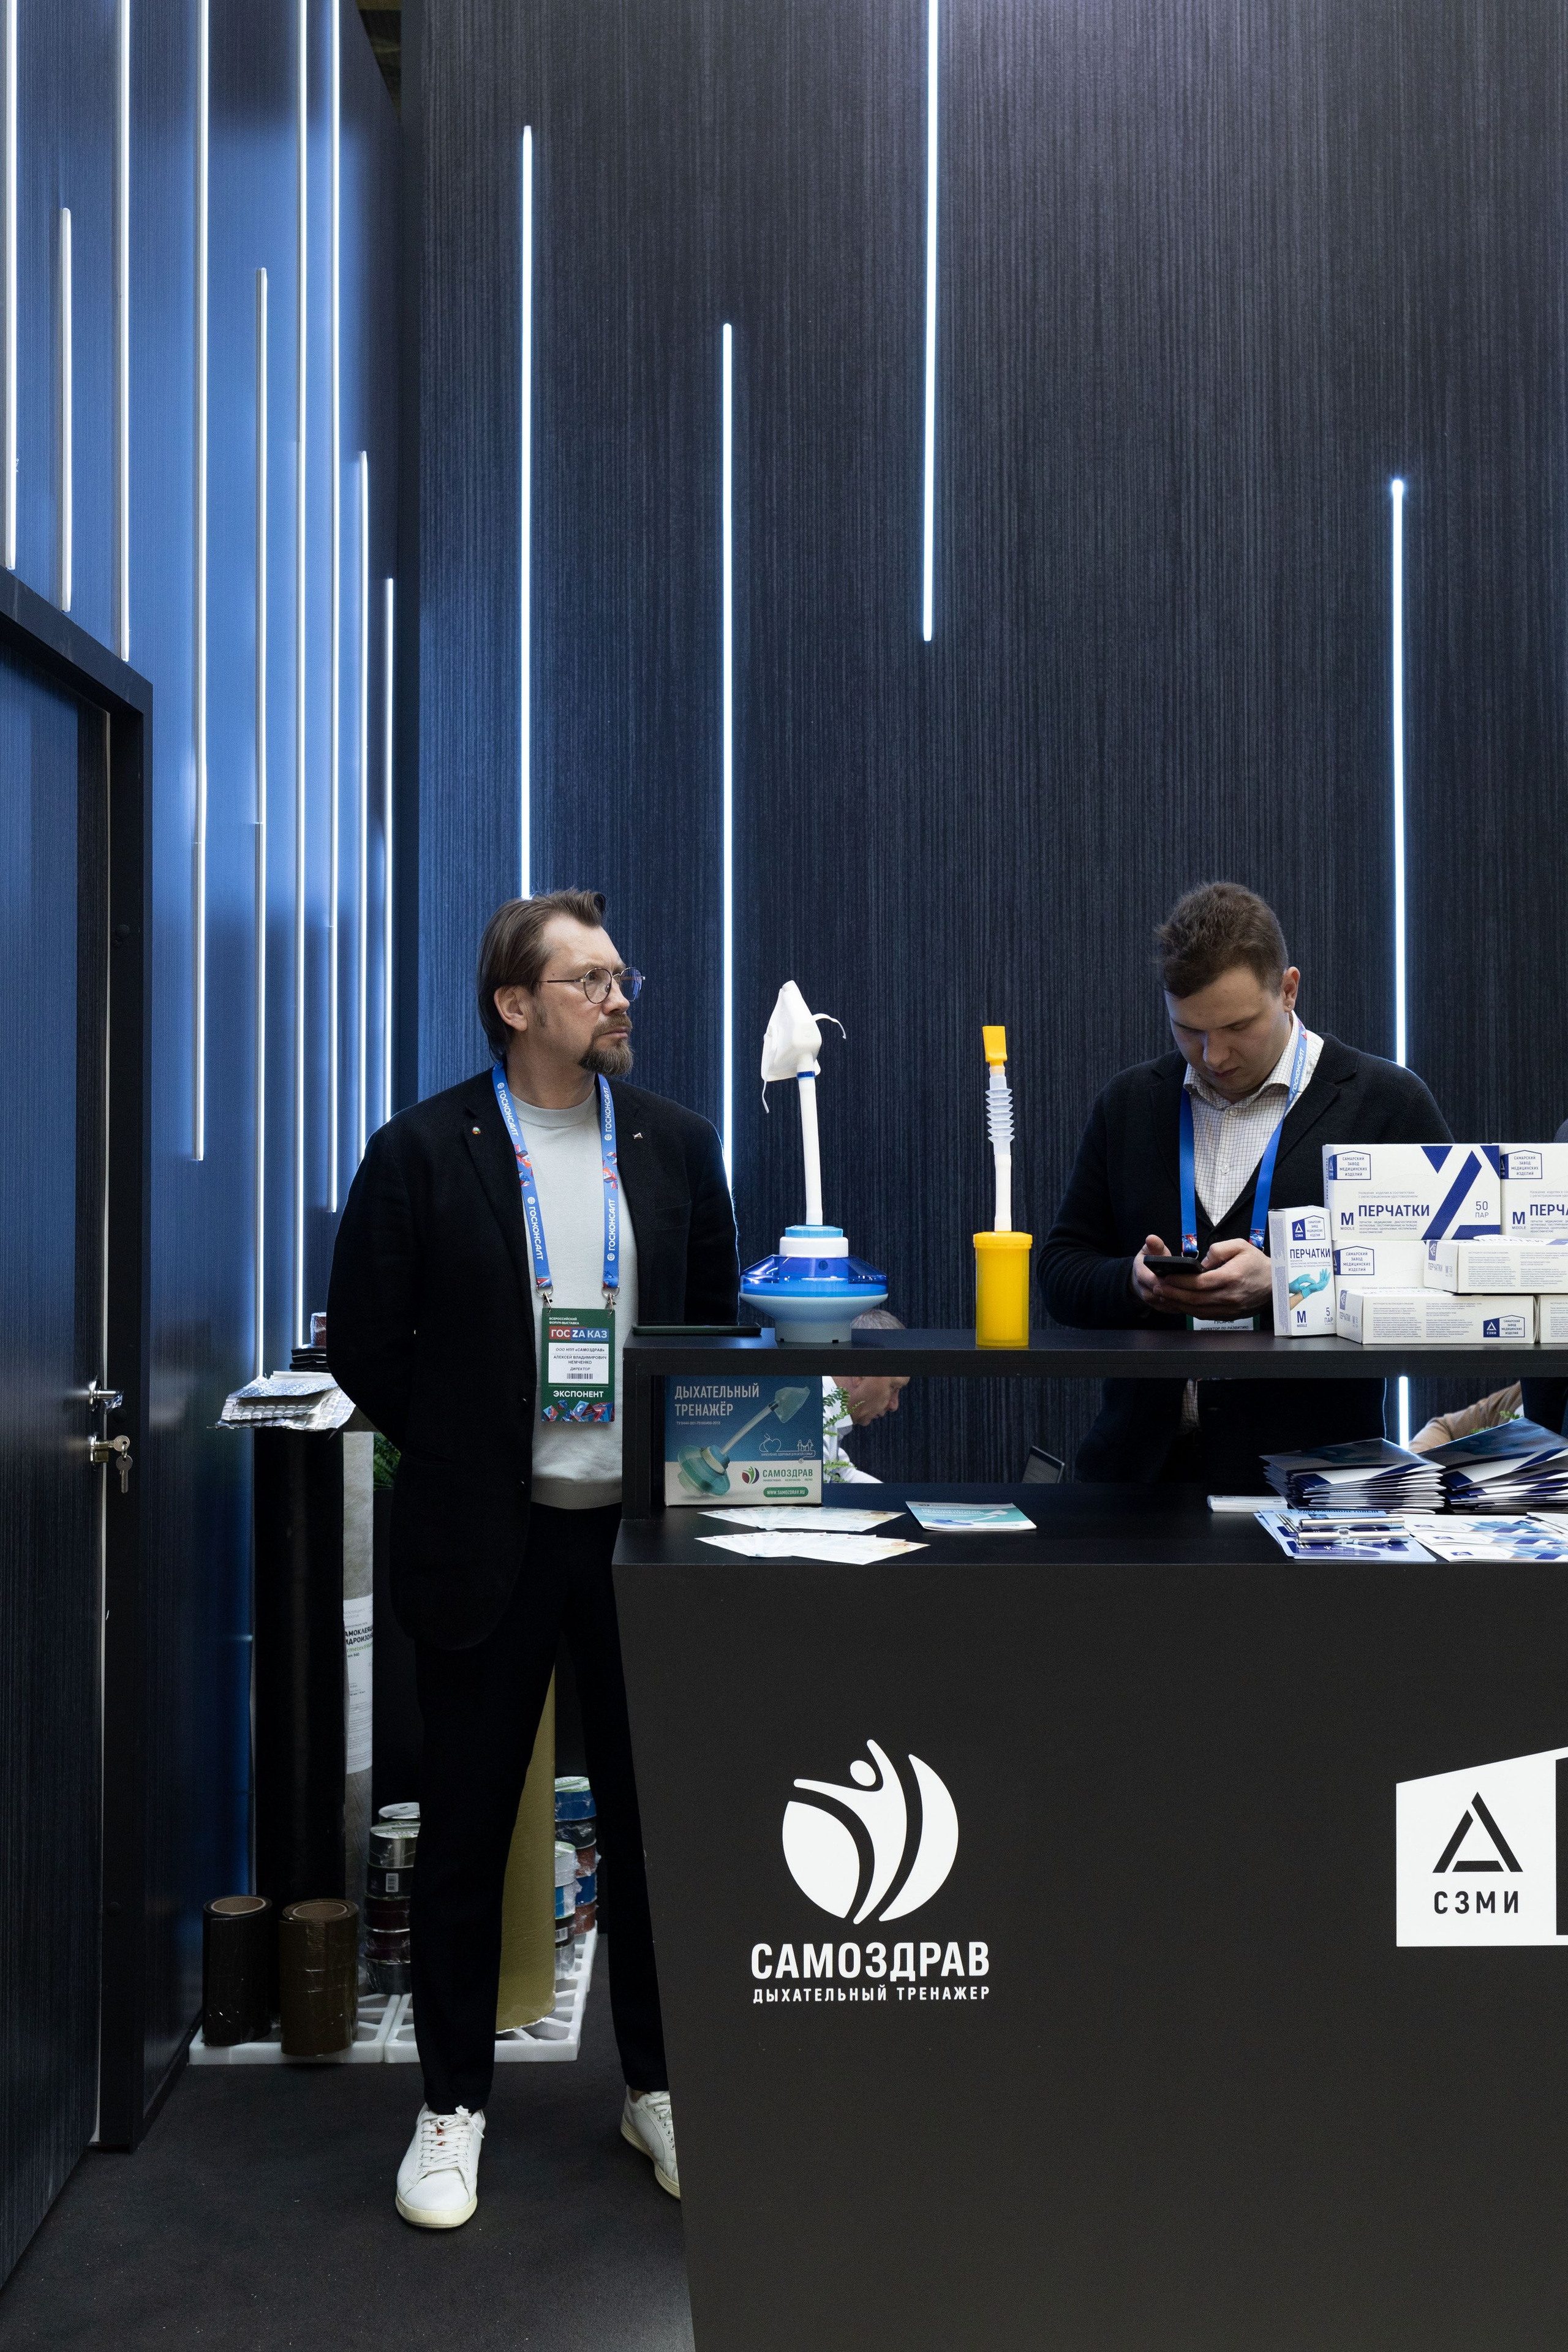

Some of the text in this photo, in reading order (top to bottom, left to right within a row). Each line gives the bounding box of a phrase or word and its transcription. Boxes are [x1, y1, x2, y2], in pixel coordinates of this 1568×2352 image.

[1292, 1047, 1305, 1093] ГОСКОНСАЛТ
[499, 1090, 519, 1137] ГОСКОНСАЛТ
[603, 1086, 612, 1132] ГОСКОНСАЛТ
[1359, 1205, 1430, 1217] ПЕРЧАТКИ
[1476, 1201, 1488, 1210] 50
[529, 1207, 544, 1261] ГОСКОНСАЛТ
[1290, 1248, 1330, 1259] ПЕРЧАТКИ
[1325, 1307, 1330, 1316] 5
[674, 1383, 759, 1400] ДЫХАТЕЛЬНЫЙ
[675, 1401, 733, 1416] ТРЕНАЖЁР
[763, 1469, 813, 1477] САМОЗДРАВ
[1434, 1890, 1518, 1915] СЗМИ
[751, 1942, 989, 1981] САМОЗДРАВ
[753, 1985, 989, 2003] ДЫХАТЕЛЬНЫЙ ТРЕНАЖЕР
